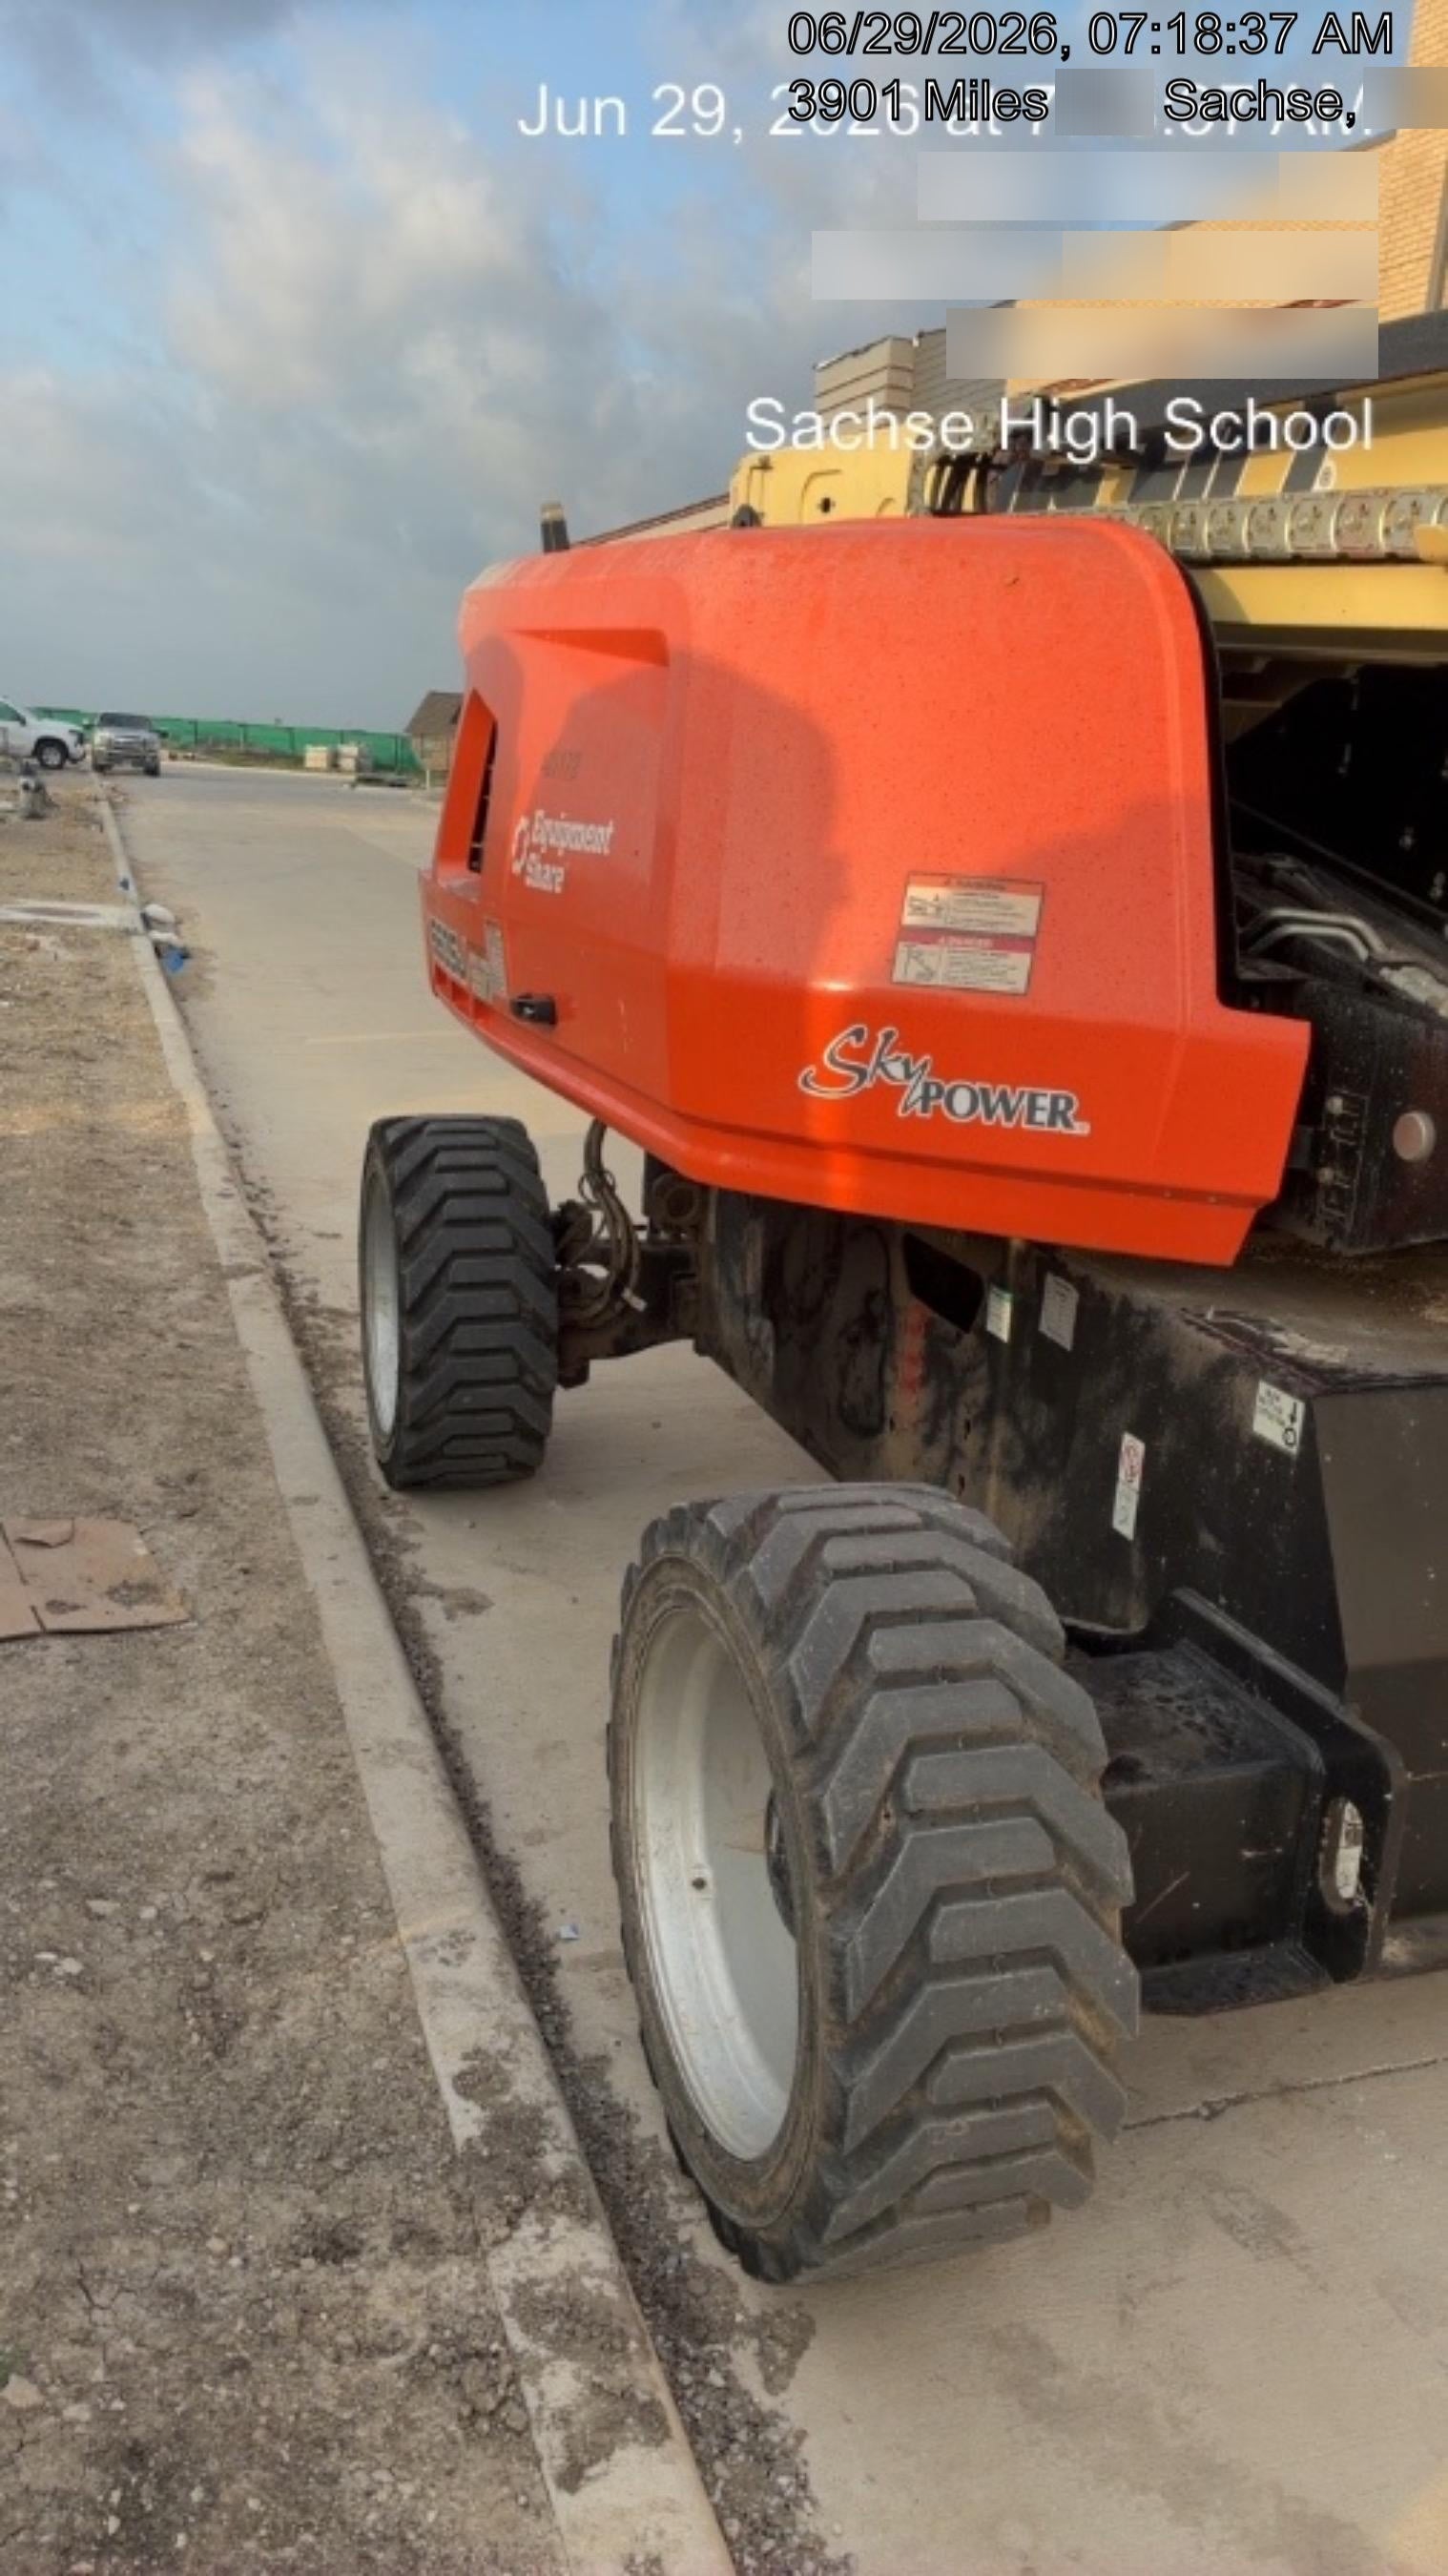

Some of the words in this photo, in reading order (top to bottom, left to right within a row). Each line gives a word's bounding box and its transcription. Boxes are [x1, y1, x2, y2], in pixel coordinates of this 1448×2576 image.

[532, 809, 613, 856] Equipment
[527, 853, 565, 893] Share
[798, 1025, 932, 1116] Sky
[916, 1079, 1079, 1131] POWER
